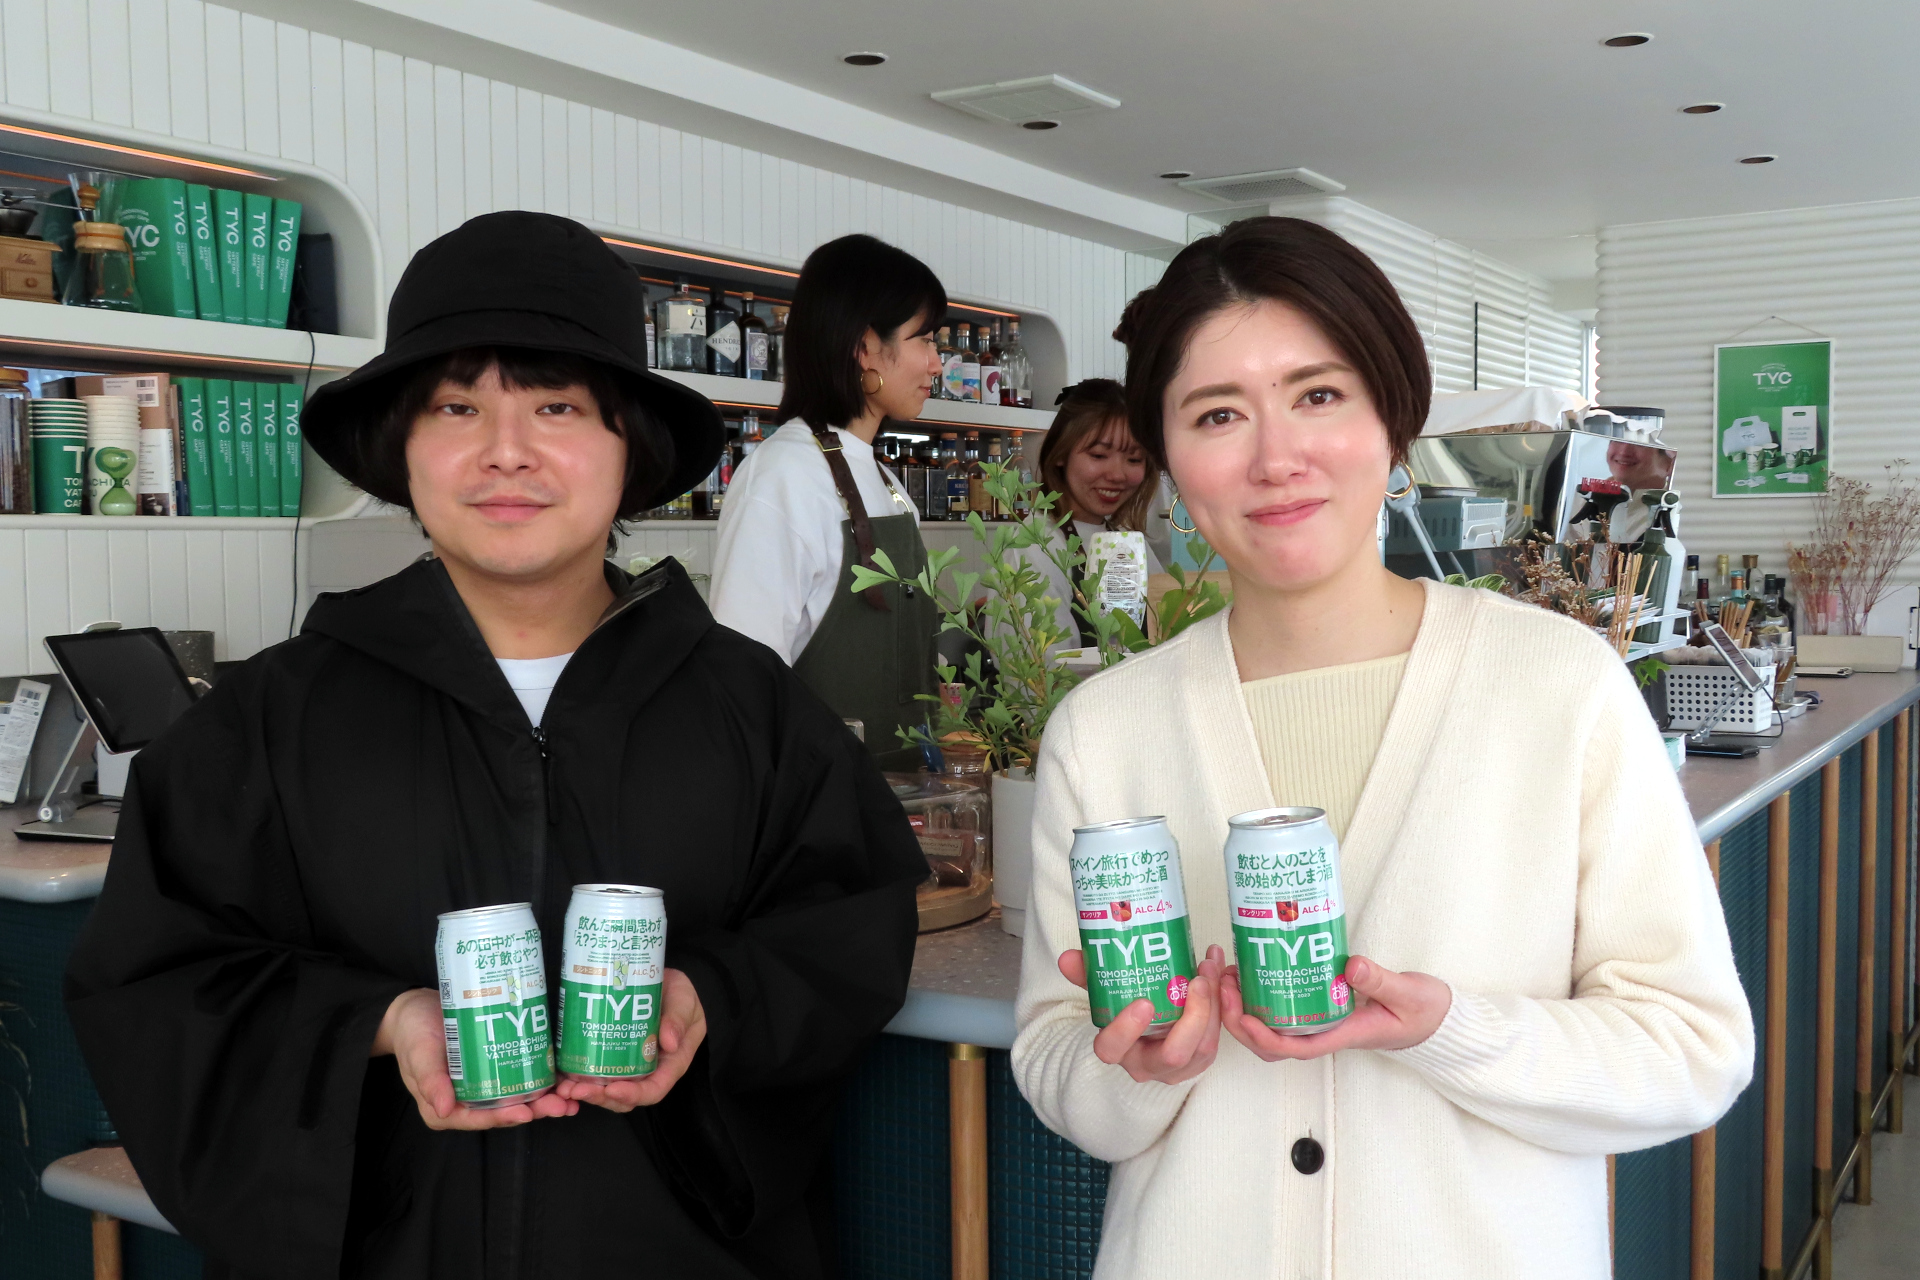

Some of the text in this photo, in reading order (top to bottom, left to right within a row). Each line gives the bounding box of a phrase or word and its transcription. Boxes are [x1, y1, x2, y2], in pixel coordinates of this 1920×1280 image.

[173, 197, 186, 235] TYC
[195, 202, 210, 240] TYC
[225, 207, 239, 245] TYC
[252, 211, 266, 249] TYC
[124, 224, 160, 248] YC
[277, 216, 294, 252] TYC
[1752, 371, 1792, 386] TYC
[190, 394, 204, 432] TYC
[217, 395, 231, 434] TYC
[239, 397, 252, 435] TYC
[263, 399, 276, 436] TYC
[286, 399, 299, 436] TYC
[1237, 846, 1326, 870] 飲むと人のことを
[1234, 863, 1333, 889] 褒め始めてしまう酒
[578, 915, 662, 934] 飲んだ瞬間思わず
[475, 947, 538, 969] 必ず飲むやつ
[1088, 931, 1172, 968] TYB
[1247, 931, 1335, 967] TYB
[1095, 964, 1170, 979] TOMODACHIGA
[1098, 972, 1169, 987] YATTERU BAR
[1255, 963, 1334, 978] TOMODACHIGA
[1258, 972, 1333, 987] YATTERU BAR
[578, 991, 653, 1021] TYB
[475, 1004, 548, 1041] TYB
[580, 1021, 649, 1031] TOMODACHIGA
[582, 1030, 647, 1039] YATTERU BAR
[483, 1034, 548, 1053] TOMODACHIGA
[486, 1042, 548, 1060] YATTERU BAR
